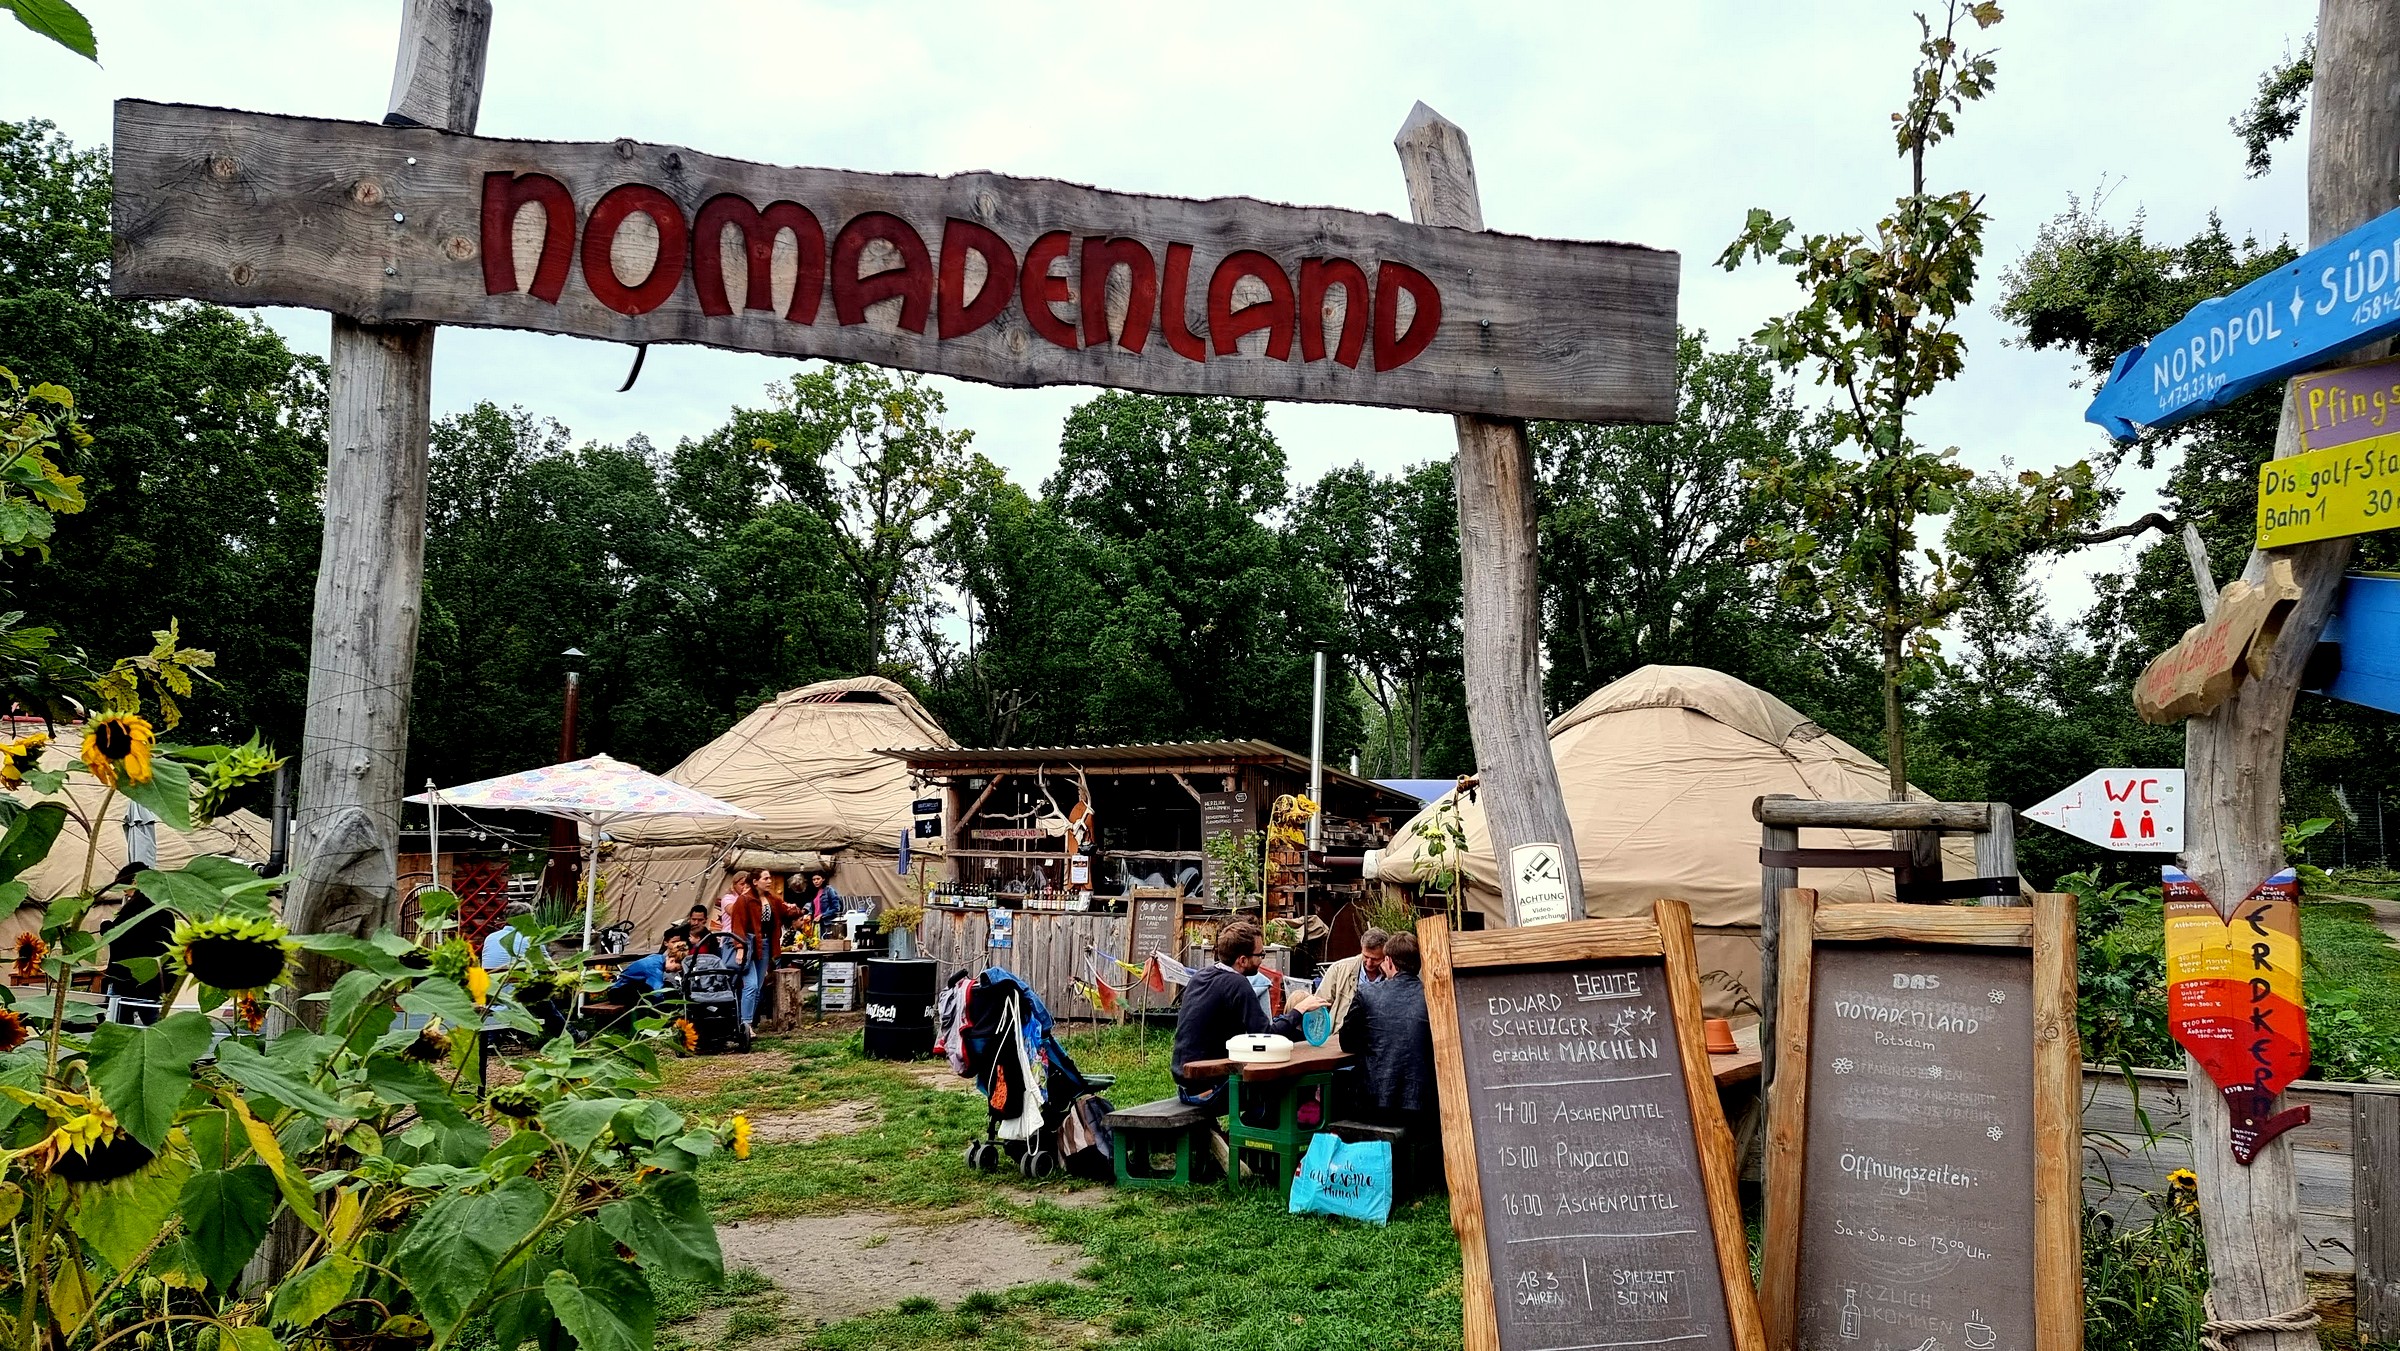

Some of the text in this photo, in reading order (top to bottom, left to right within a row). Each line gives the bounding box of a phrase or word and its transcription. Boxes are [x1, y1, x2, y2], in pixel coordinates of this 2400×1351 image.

[480, 170, 1442, 373] NOMADENLAND
[2153, 301, 2282, 396] NORDPOL
[2206, 372, 2227, 394] km
[2265, 504, 2310, 531] Bahn
[2315, 496, 2327, 522] 1
[2363, 489, 2393, 517] 30
[2104, 779, 2159, 804] WC
[1520, 893, 1565, 906] ACHTUNG
[1573, 972, 1641, 996] HEUTE
[1892, 973, 1941, 990] DAS
[1488, 994, 1562, 1016] EDWARD
[2245, 904, 2278, 1117] ERDKERN
[1489, 1017, 1593, 1037] SCHEUZGER
[1835, 1001, 1980, 1035] NOMADENLAND
[2182, 1019, 2201, 1028] 5100
[1492, 1038, 1658, 1063] erzählt MÄRCHEN
[1875, 1031, 1936, 1051] Potsdam
[1495, 1101, 1665, 1125] 14:00 ASCHENPUTTEL
[1498, 1146, 1538, 1169] 15:00
[1556, 1142, 1630, 1173] PINOCCIO
[1309, 1169, 1375, 1188] awesome
[1840, 1147, 1979, 1196] Öffnungszeiten:
[1502, 1194, 1543, 1217] 16:00
[1556, 1193, 1680, 1217] ASCHENPUTTEL
[1834, 1219, 1854, 1236] Sa
[1867, 1227, 1893, 1242] So:
[1897, 1234, 1917, 1247] ab
[1966, 1245, 1992, 1260] Uhr
[1516, 1270, 1560, 1290] AB 3
[1612, 1268, 1676, 1286] SPIELZEIT
[1517, 1291, 1565, 1306] JAHREN
[1616, 1289, 1669, 1306] 30 MIN
